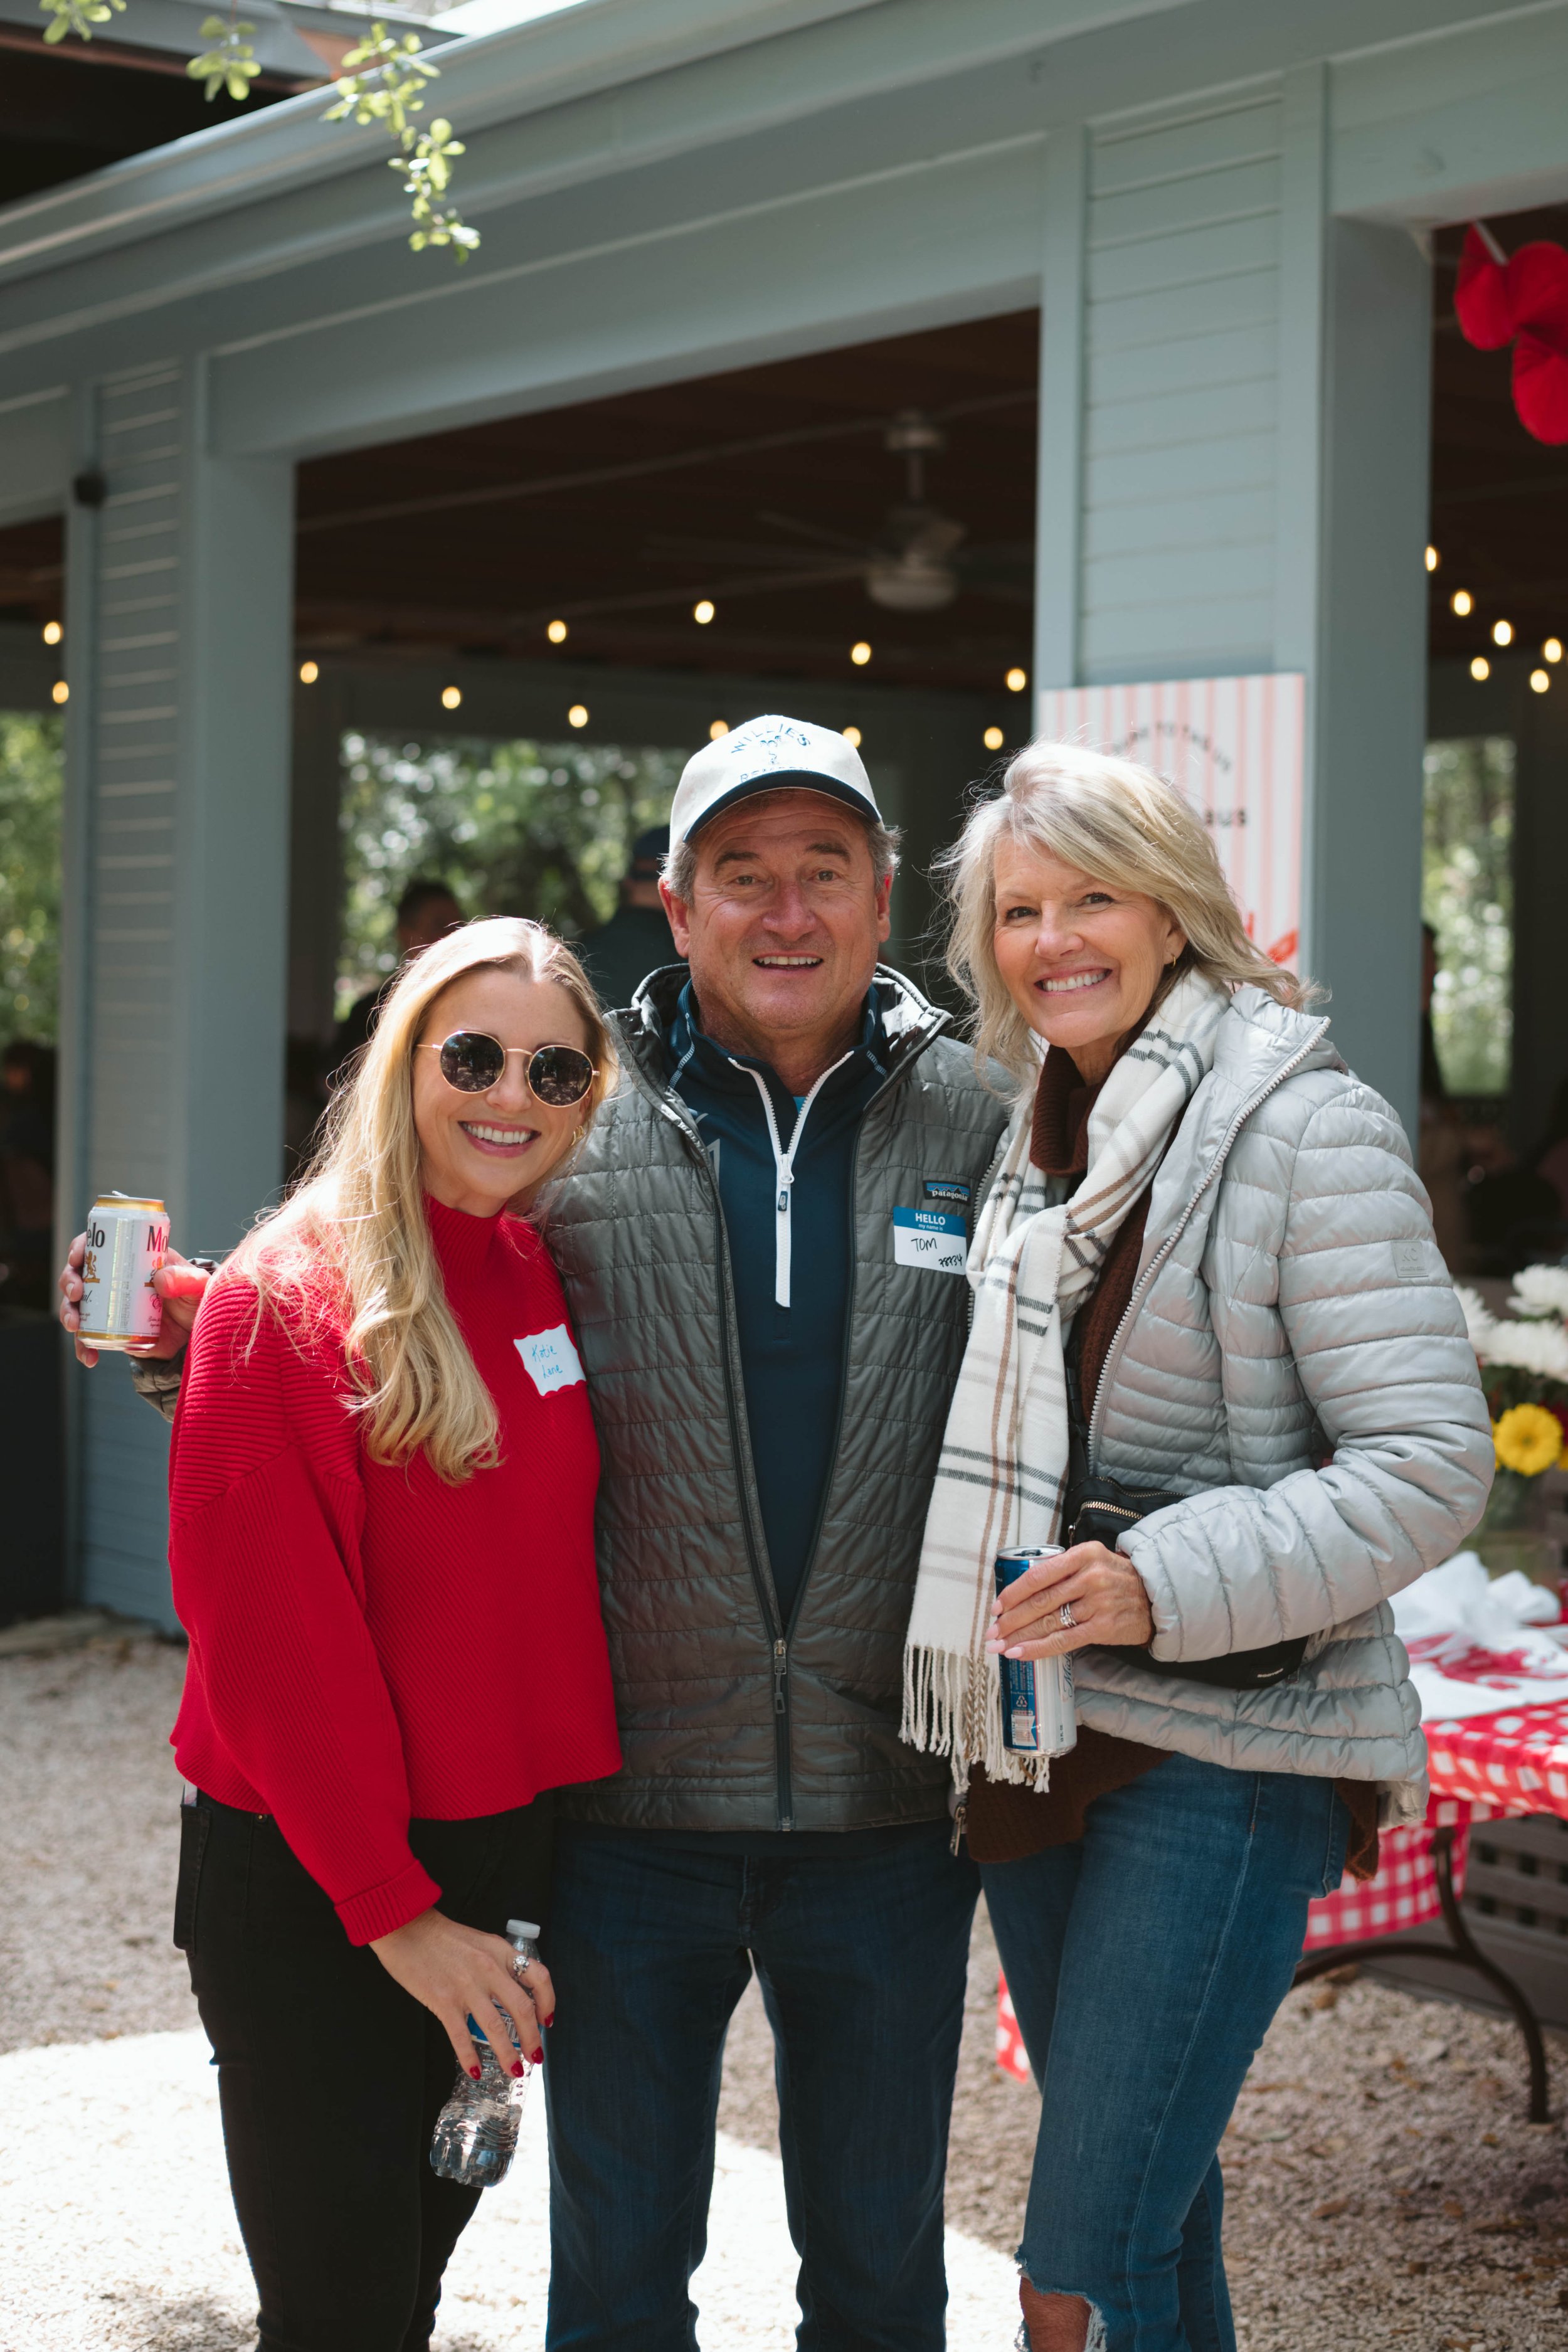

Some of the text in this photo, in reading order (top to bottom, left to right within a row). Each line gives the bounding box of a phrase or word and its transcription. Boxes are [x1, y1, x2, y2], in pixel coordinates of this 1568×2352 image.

[731, 723, 811, 753] WILLIE'S
[932, 1190, 968, 1201] patagonia
[915, 1212, 946, 1225] HELLO
[911, 1237, 938, 1252] TOM
[938, 1253, 963, 1268] 78734
[532, 1344, 557, 1362] Katie
